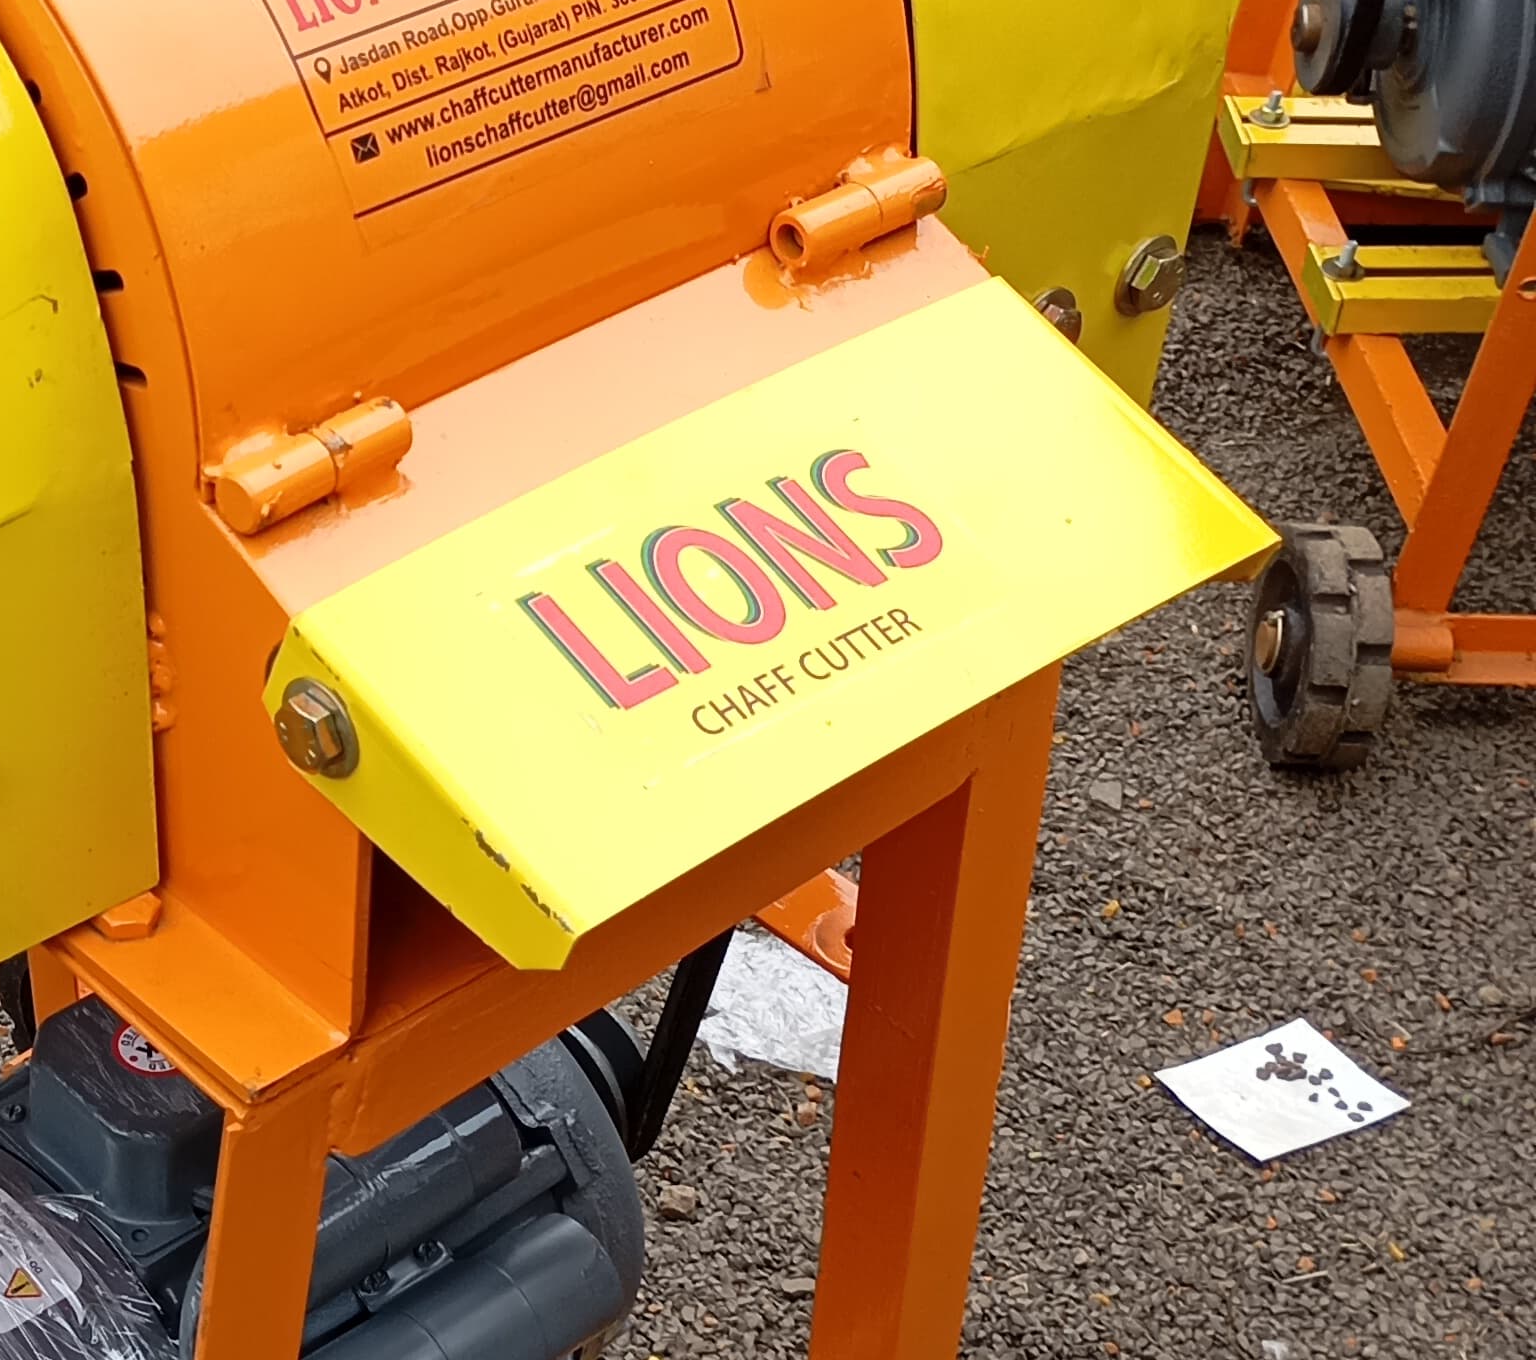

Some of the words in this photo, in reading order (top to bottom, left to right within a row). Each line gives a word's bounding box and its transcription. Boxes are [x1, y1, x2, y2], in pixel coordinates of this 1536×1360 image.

[338, 40, 402, 77] Jasdan
[338, 82, 392, 115] Atkot,
[391, 64, 435, 93] Dist.
[435, 40, 498, 75] Rajkot,
[497, 8, 572, 56] (Gujarat)
[384, 4, 711, 145] www.chaffcuttermanufacturer.com
[425, 48, 692, 169] lionschaffcutter@gmail.com
[515, 448, 944, 711] LIONS
[690, 663, 798, 736] CHAFF
[798, 607, 925, 681] CUTTER
